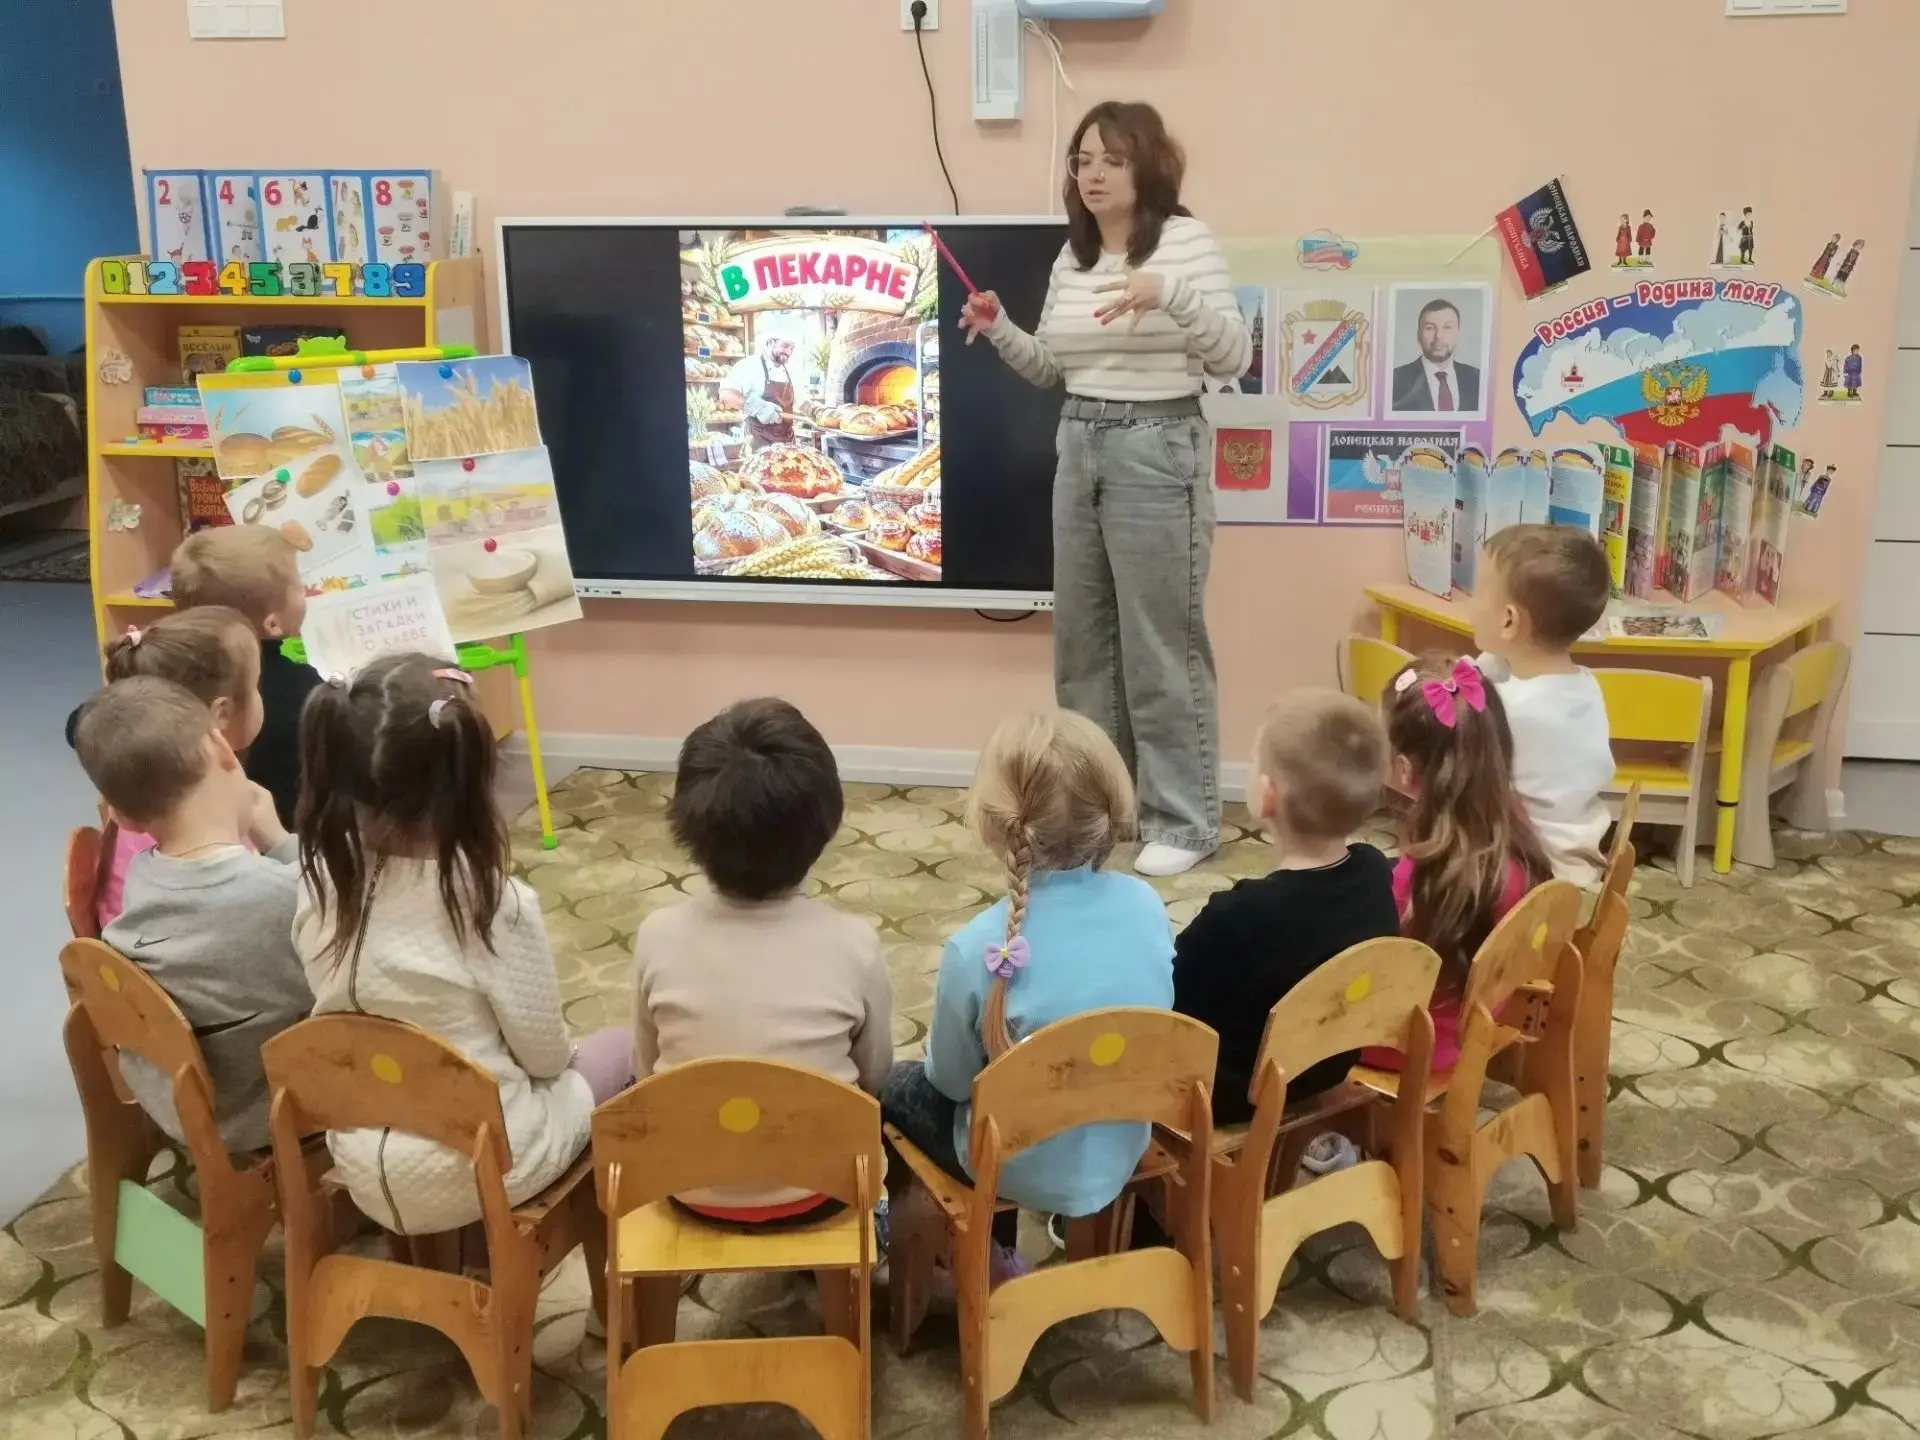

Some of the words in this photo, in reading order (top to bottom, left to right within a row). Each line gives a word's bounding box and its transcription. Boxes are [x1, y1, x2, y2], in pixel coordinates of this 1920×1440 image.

[157, 179, 172, 205] 2
[219, 180, 235, 205] 4
[264, 180, 283, 206] 6
[375, 180, 393, 206] 8
[721, 265, 750, 301] В
[753, 252, 911, 300] ПЕКАРНЕ
[1537, 299, 1609, 346] Россия
[1637, 280, 1715, 307] Родина
[1725, 281, 1781, 308] моя!
[1331, 435, 1394, 447] ДОНЕЦКАЯ
[1397, 436, 1459, 447] НАРОДНАЯ
[1354, 503, 1403, 514] РЕСПУБ
[352, 600, 402, 620] СТИХИ
[407, 596, 418, 607] И
[357, 612, 426, 636] ЗАГАДКИ
[364, 640, 376, 651] О
[382, 626, 428, 648] ХЛЕБЕ
